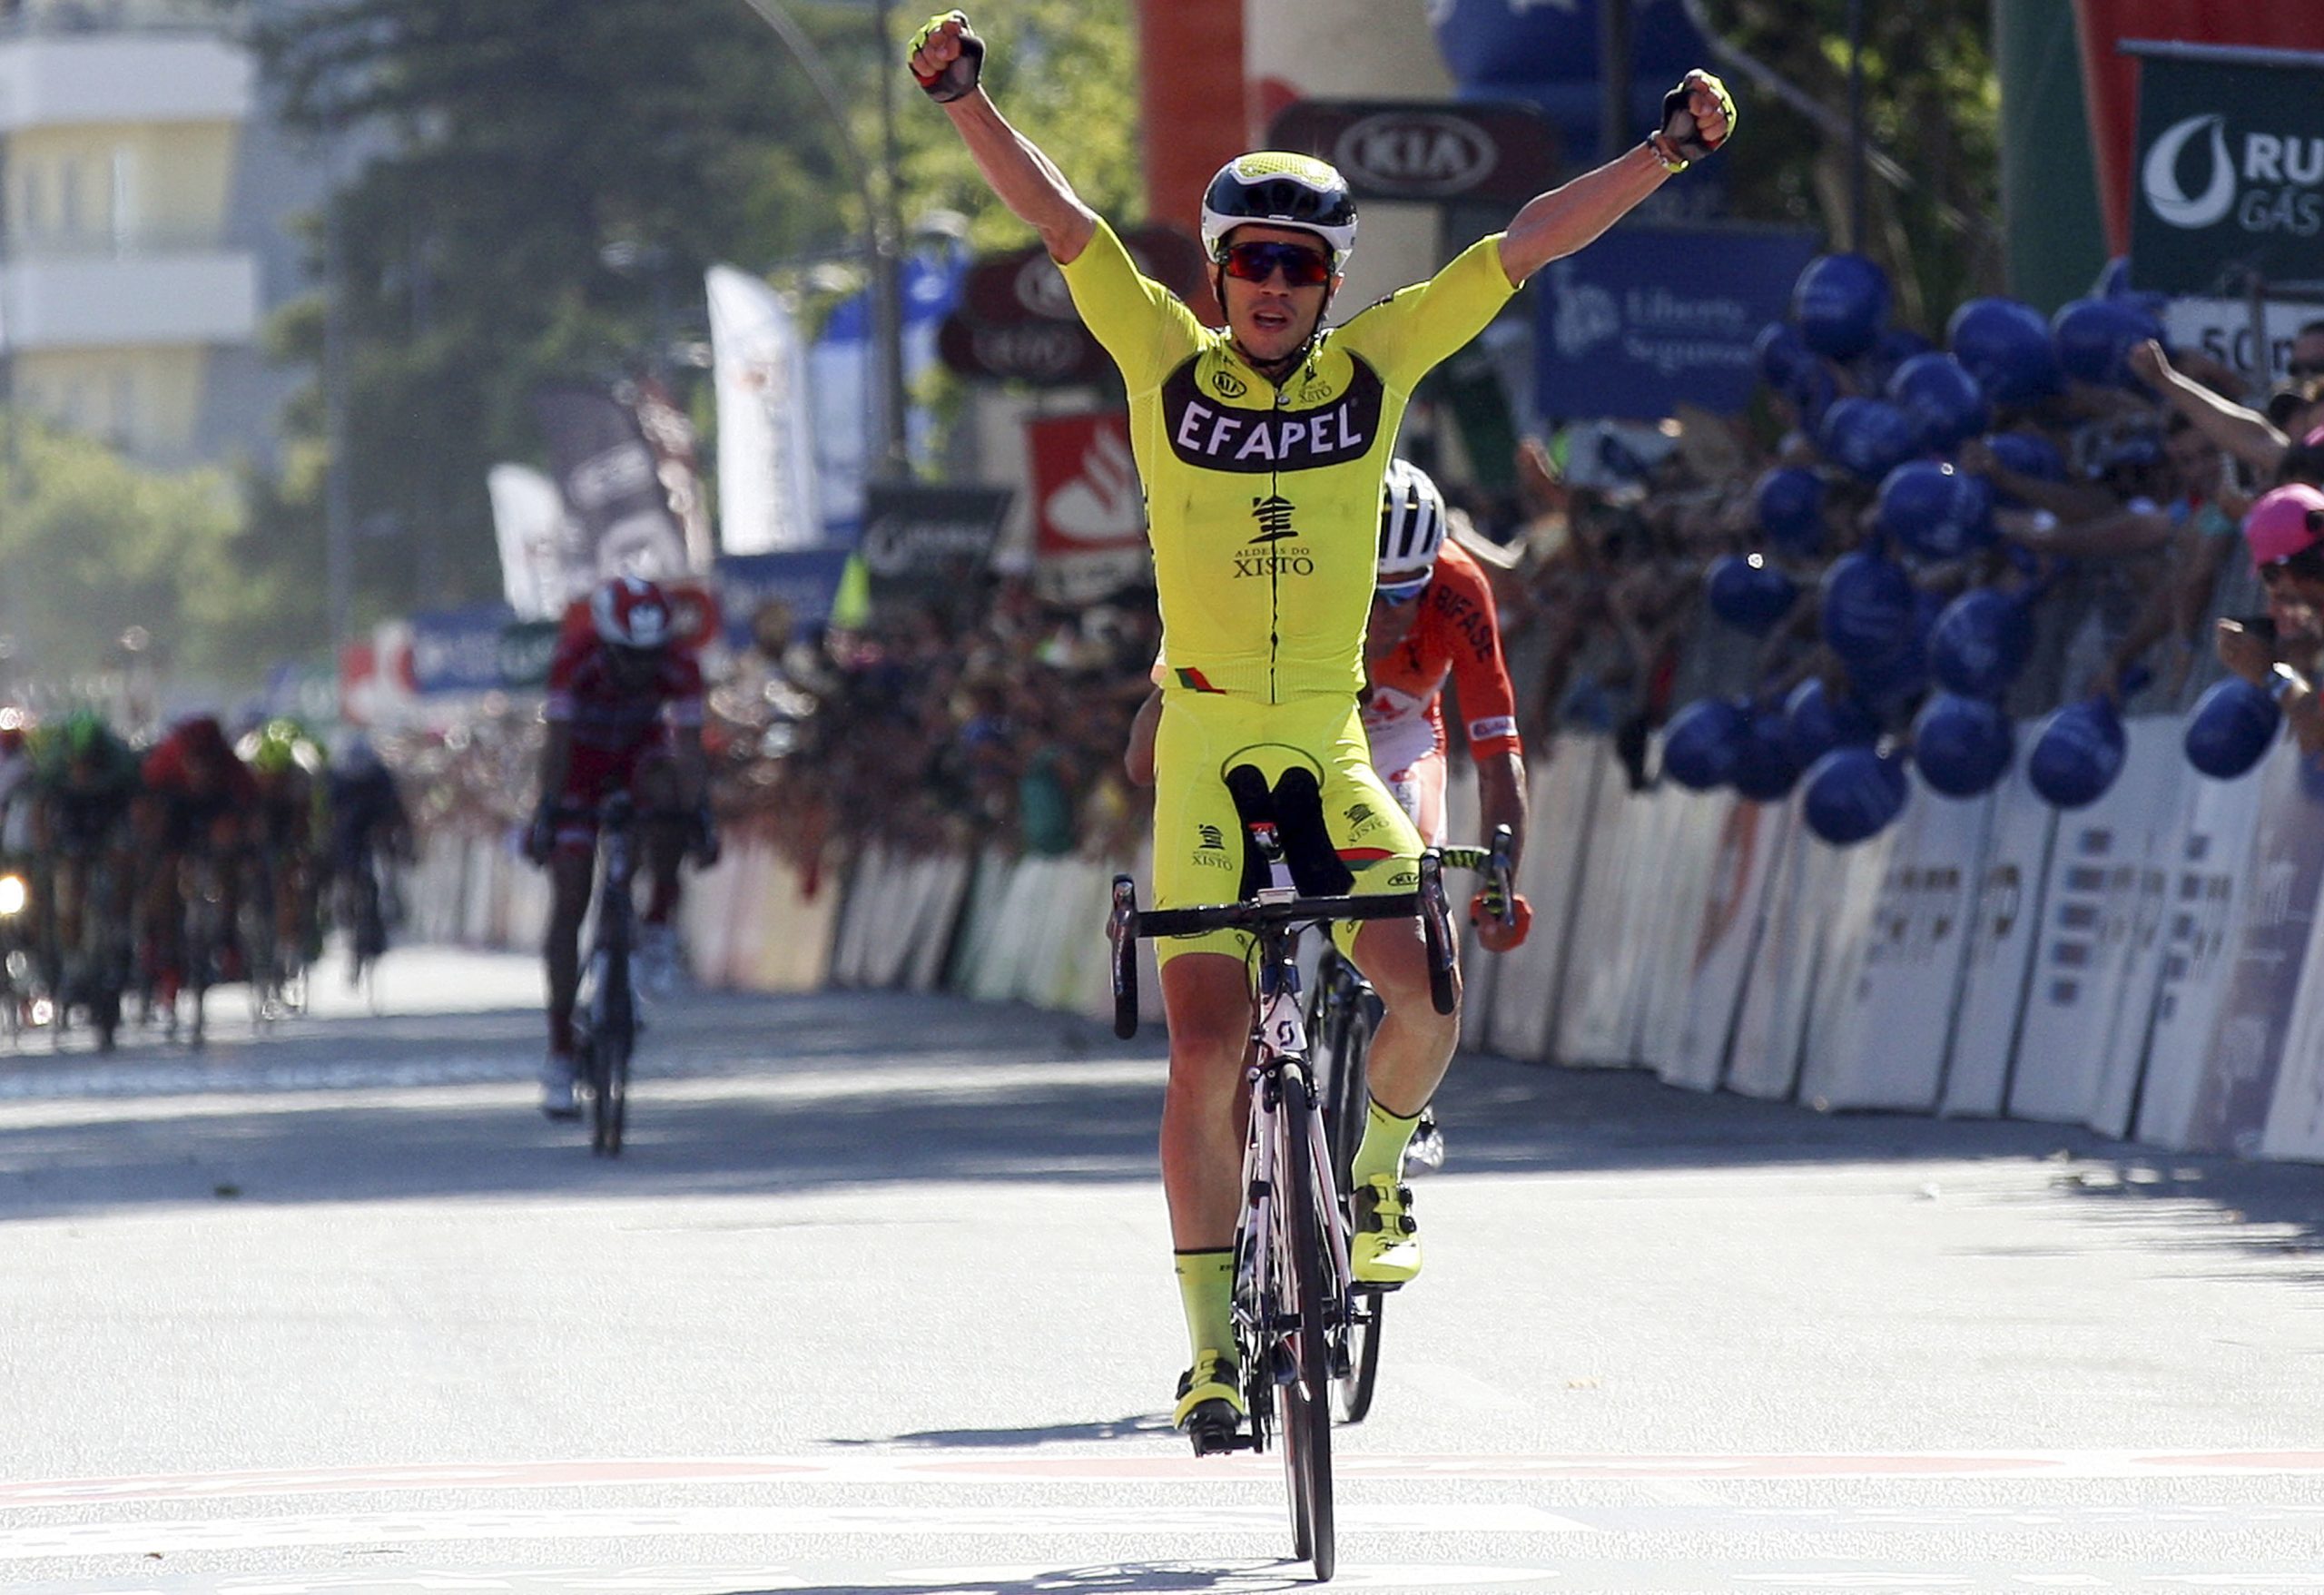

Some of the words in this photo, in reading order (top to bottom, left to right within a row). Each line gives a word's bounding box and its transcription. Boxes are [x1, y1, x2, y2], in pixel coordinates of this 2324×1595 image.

[1177, 400, 1362, 460] EFAPEL
[1291, 547, 1309, 556] DO
[1234, 556, 1314, 578] XISTO
[1191, 855, 1233, 871] XISTO
